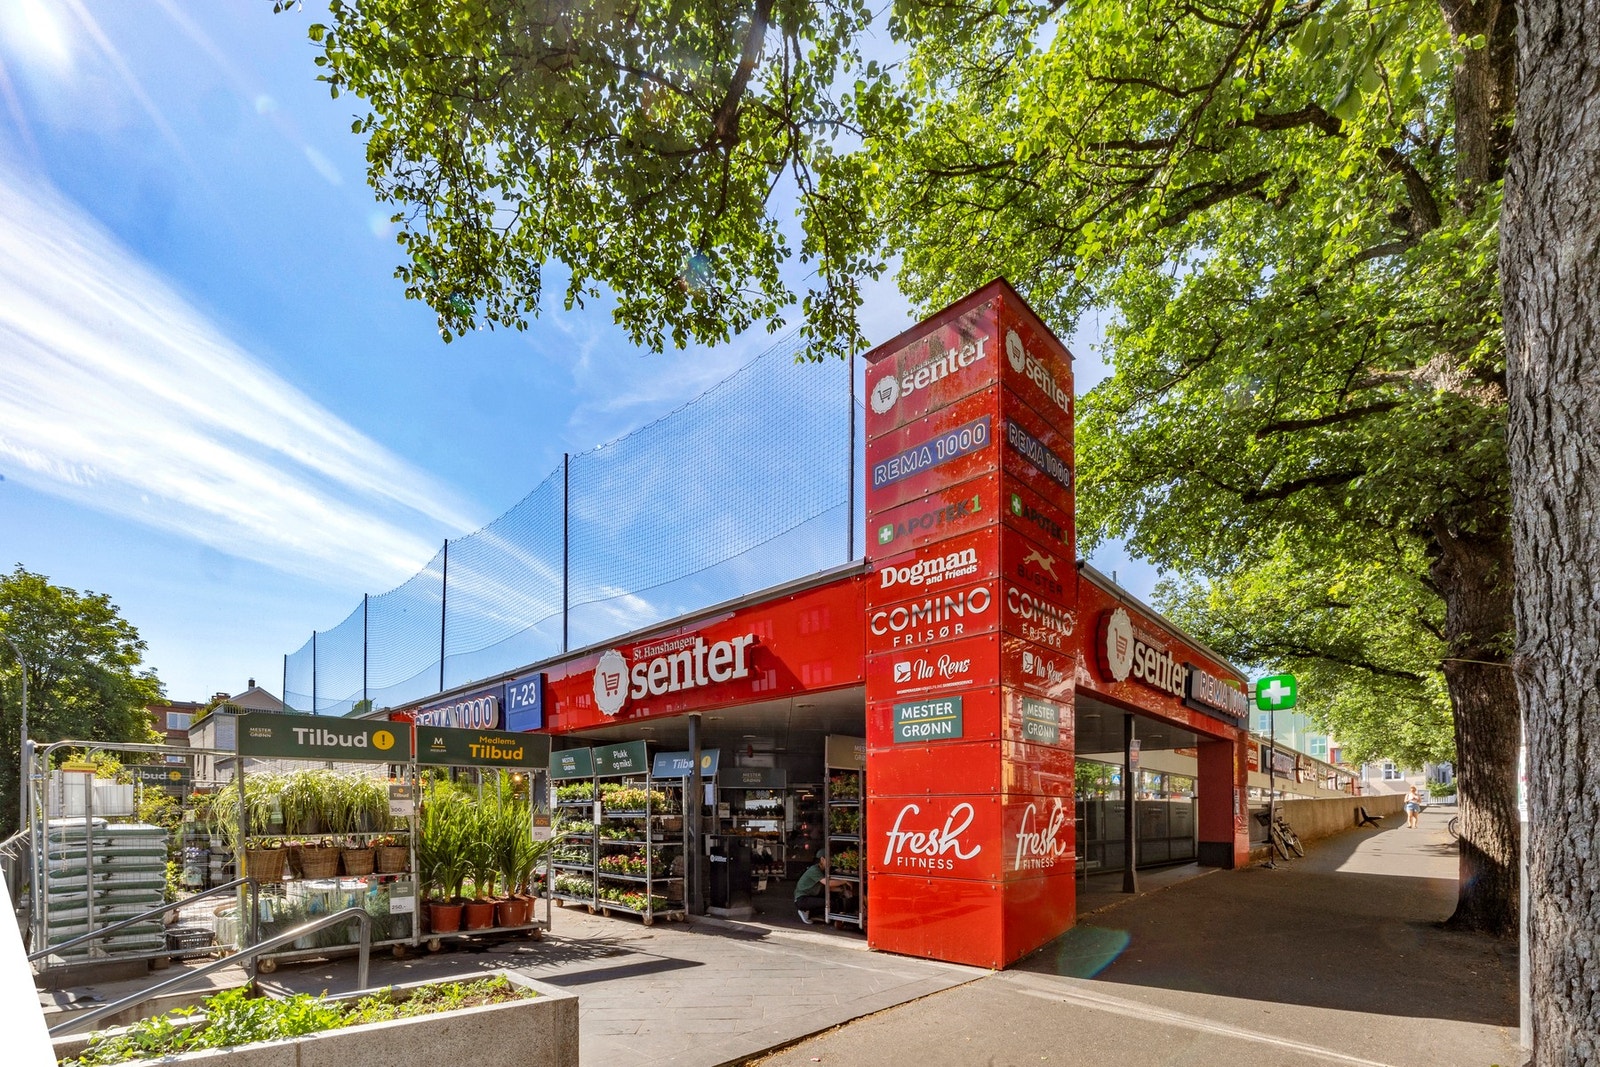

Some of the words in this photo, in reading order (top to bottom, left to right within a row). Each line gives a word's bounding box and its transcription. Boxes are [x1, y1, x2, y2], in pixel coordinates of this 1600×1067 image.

[901, 334, 989, 397] senter
[1026, 357, 1070, 415] senter
[874, 447, 931, 485] REMA
[936, 423, 986, 460] 1000
[1009, 422, 1044, 468] REMA
[1046, 452, 1070, 487] 1000
[895, 498, 969, 539] APOTEK
[971, 494, 982, 513] 1
[1023, 505, 1062, 540] APOTEK
[880, 548, 978, 589] Dogman
[926, 574, 943, 586] and
[945, 564, 978, 580] friends
[1017, 564, 1063, 595] BUSTER
[870, 587, 991, 636] COMINO
[1008, 587, 1073, 636] COMINO
[893, 623, 964, 648] FRISØR
[631, 633, 754, 700] senter
[634, 649, 644, 660] St.
[937, 654, 971, 680] Rens
[1133, 642, 1189, 699] senter
[510, 682, 536, 708] 7-23
[1200, 670, 1228, 710] REMA
[1229, 686, 1248, 718] 1000
[456, 697, 493, 729] 1000
[901, 702, 953, 720] MESTER
[1027, 703, 1055, 720] MESTER
[293, 727, 368, 748] Tilbud
[434, 737, 443, 745] M
[479, 736, 516, 745] Medlems
[902, 721, 952, 738] GRØNN
[1027, 722, 1055, 739] GRØNN
[469, 744, 524, 760] Tilbud
[612, 750, 628, 759] Plukk
[672, 758, 691, 769] Tilb
[612, 761, 620, 770] og
[883, 802, 981, 866] fresh
[1014, 800, 1066, 871] fresh
[897, 856, 954, 870] FITNESS
[1023, 858, 1055, 870] FITNESS
